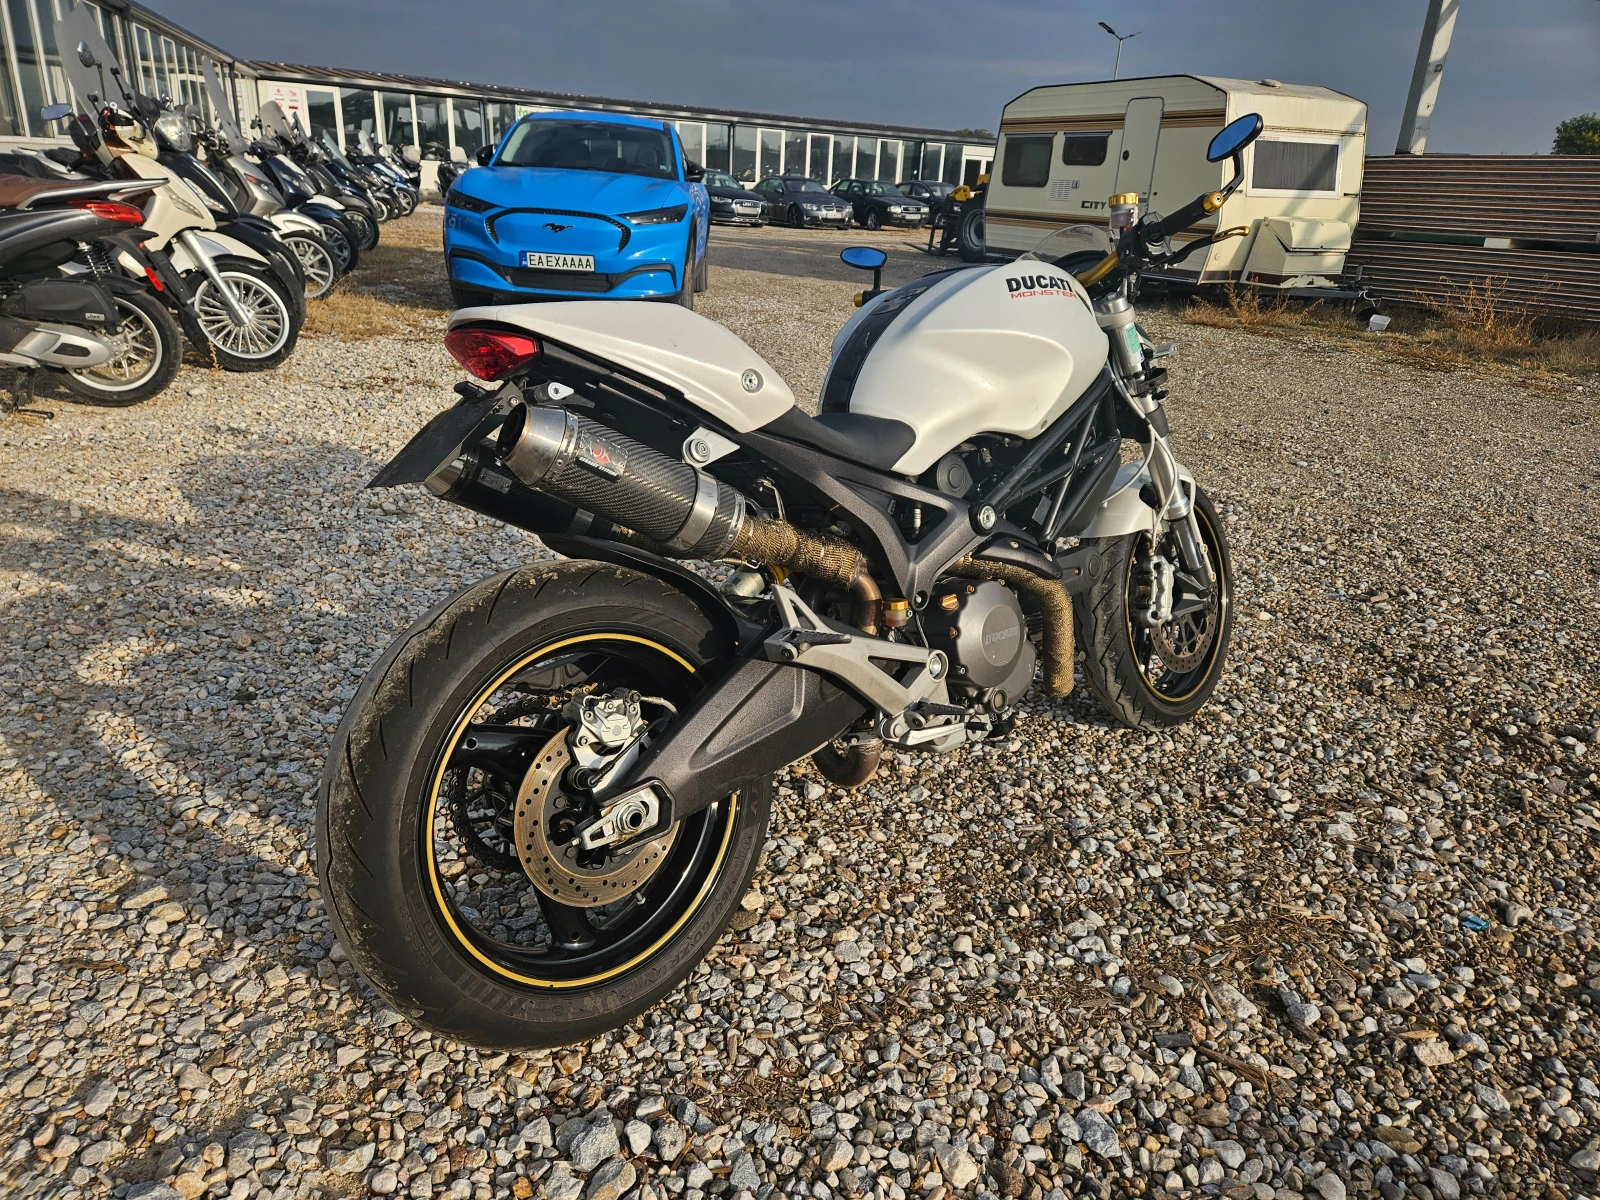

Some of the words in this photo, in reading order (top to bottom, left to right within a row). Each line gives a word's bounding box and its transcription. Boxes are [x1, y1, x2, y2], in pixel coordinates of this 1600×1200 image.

[1081, 200, 1106, 209] CITY
[1006, 275, 1073, 292] DUCATI
[1011, 289, 1077, 299] MONSTER
[985, 625, 1018, 646] DUCATI
